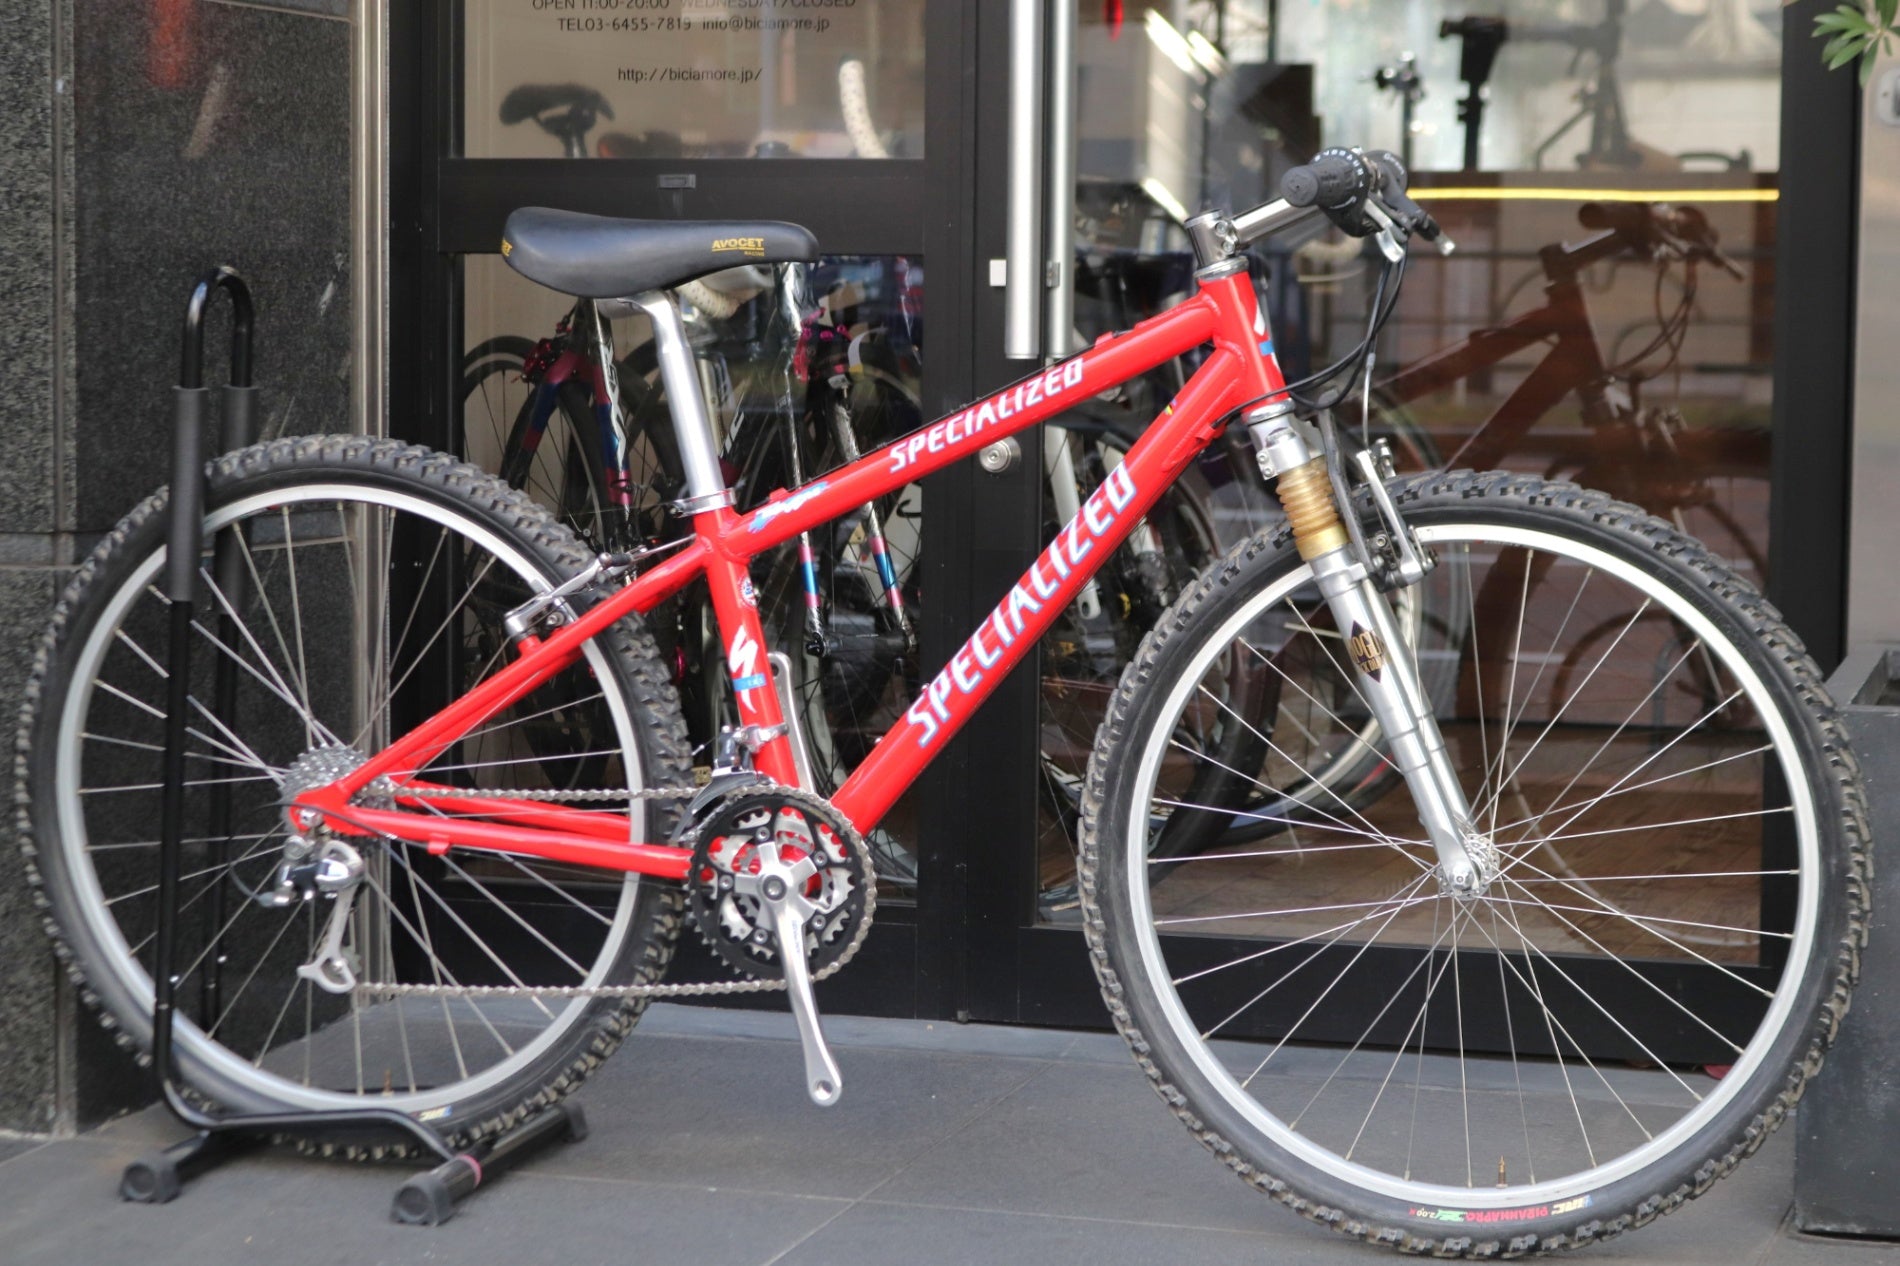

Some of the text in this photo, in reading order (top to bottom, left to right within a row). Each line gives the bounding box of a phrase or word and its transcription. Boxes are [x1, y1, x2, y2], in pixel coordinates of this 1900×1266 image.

[532, 0, 575, 10] OPEN
[702, 16, 830, 32] info@biciamore.jp
[618, 67, 763, 84] http://biciamore.jp/
[711, 238, 764, 249] AVOCET
[889, 357, 1084, 474] SPECIALIZED
[906, 460, 1137, 748] SPECIALIZED
